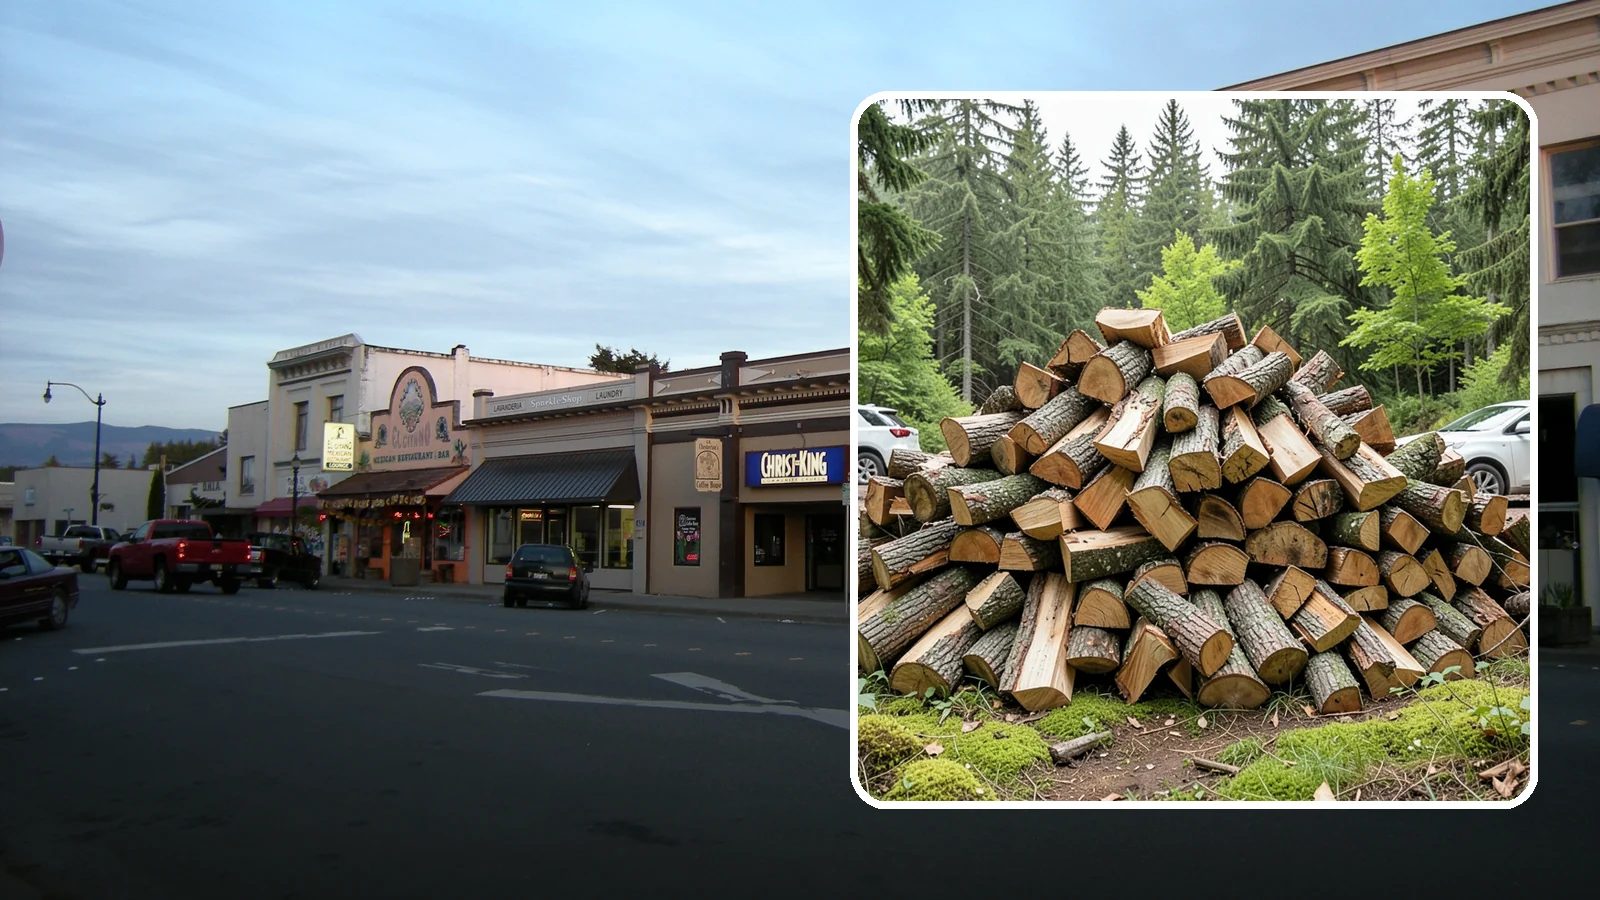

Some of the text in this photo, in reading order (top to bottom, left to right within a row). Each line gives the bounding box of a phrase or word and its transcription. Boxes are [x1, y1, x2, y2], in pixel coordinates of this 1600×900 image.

[562, 394, 583, 404] Shop
[595, 389, 623, 400] LAUNDRY
[493, 402, 523, 413] LAVANDERIA
[373, 455, 396, 464] MEXICAN
[397, 451, 433, 462] RESTAURANT
[438, 450, 450, 458] BAR
[799, 450, 828, 477] KING
